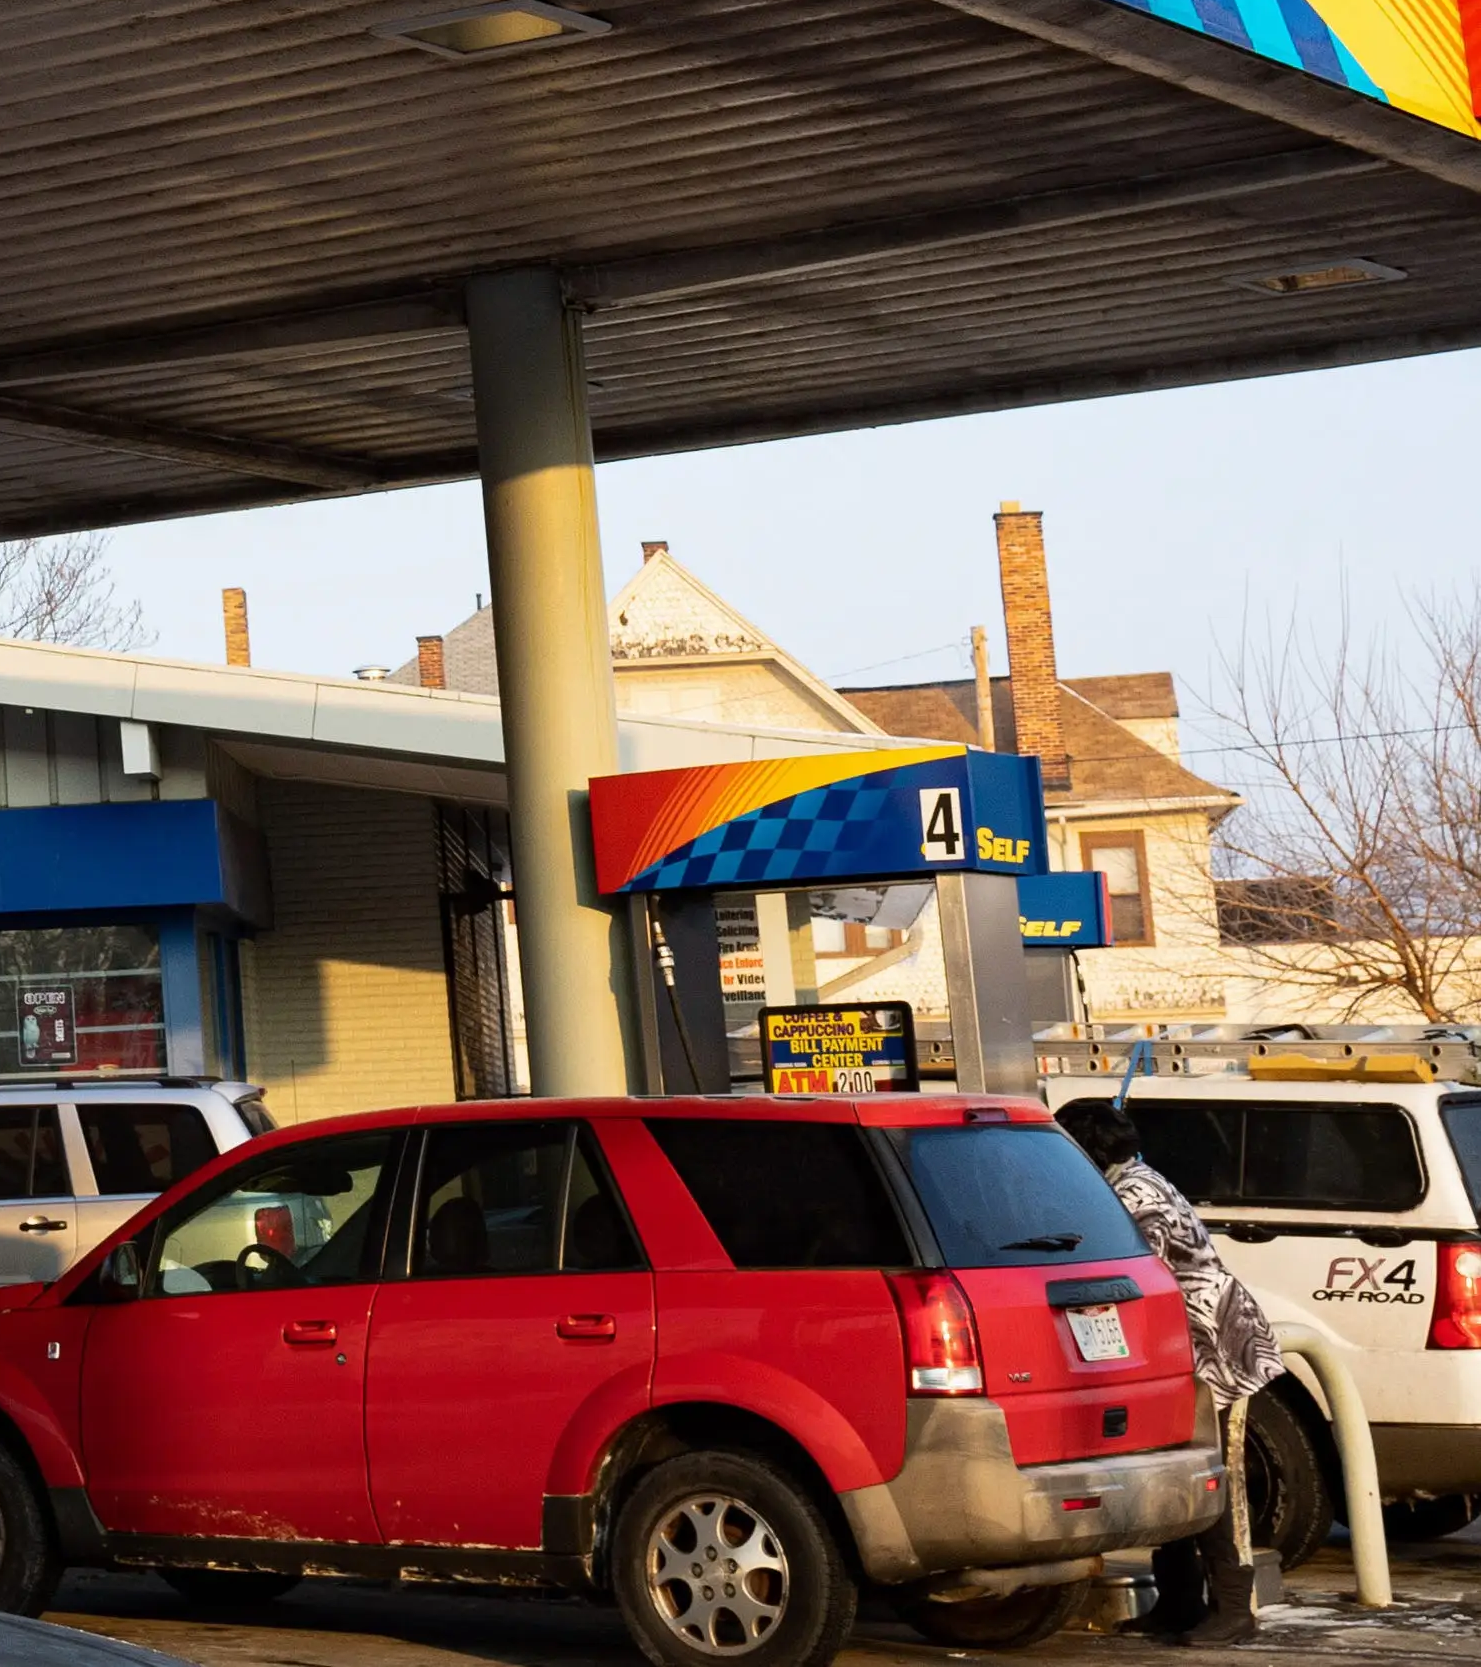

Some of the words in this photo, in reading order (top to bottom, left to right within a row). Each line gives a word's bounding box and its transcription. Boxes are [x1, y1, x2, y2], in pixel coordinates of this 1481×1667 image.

[925, 793, 960, 855] 4
[975, 826, 1030, 864] SELF
[24, 992, 65, 1005] OPEN
[773, 1024, 855, 1038] CAPPUCCINO
[790, 1039, 819, 1054] BILL
[822, 1038, 884, 1053] PAYMENT
[812, 1053, 864, 1067] CENTER
[779, 1071, 829, 1094] ATM
[1325, 1257, 1417, 1292] FX4
[1312, 1290, 1354, 1302] OFF
[1358, 1291, 1424, 1305] ROAD
